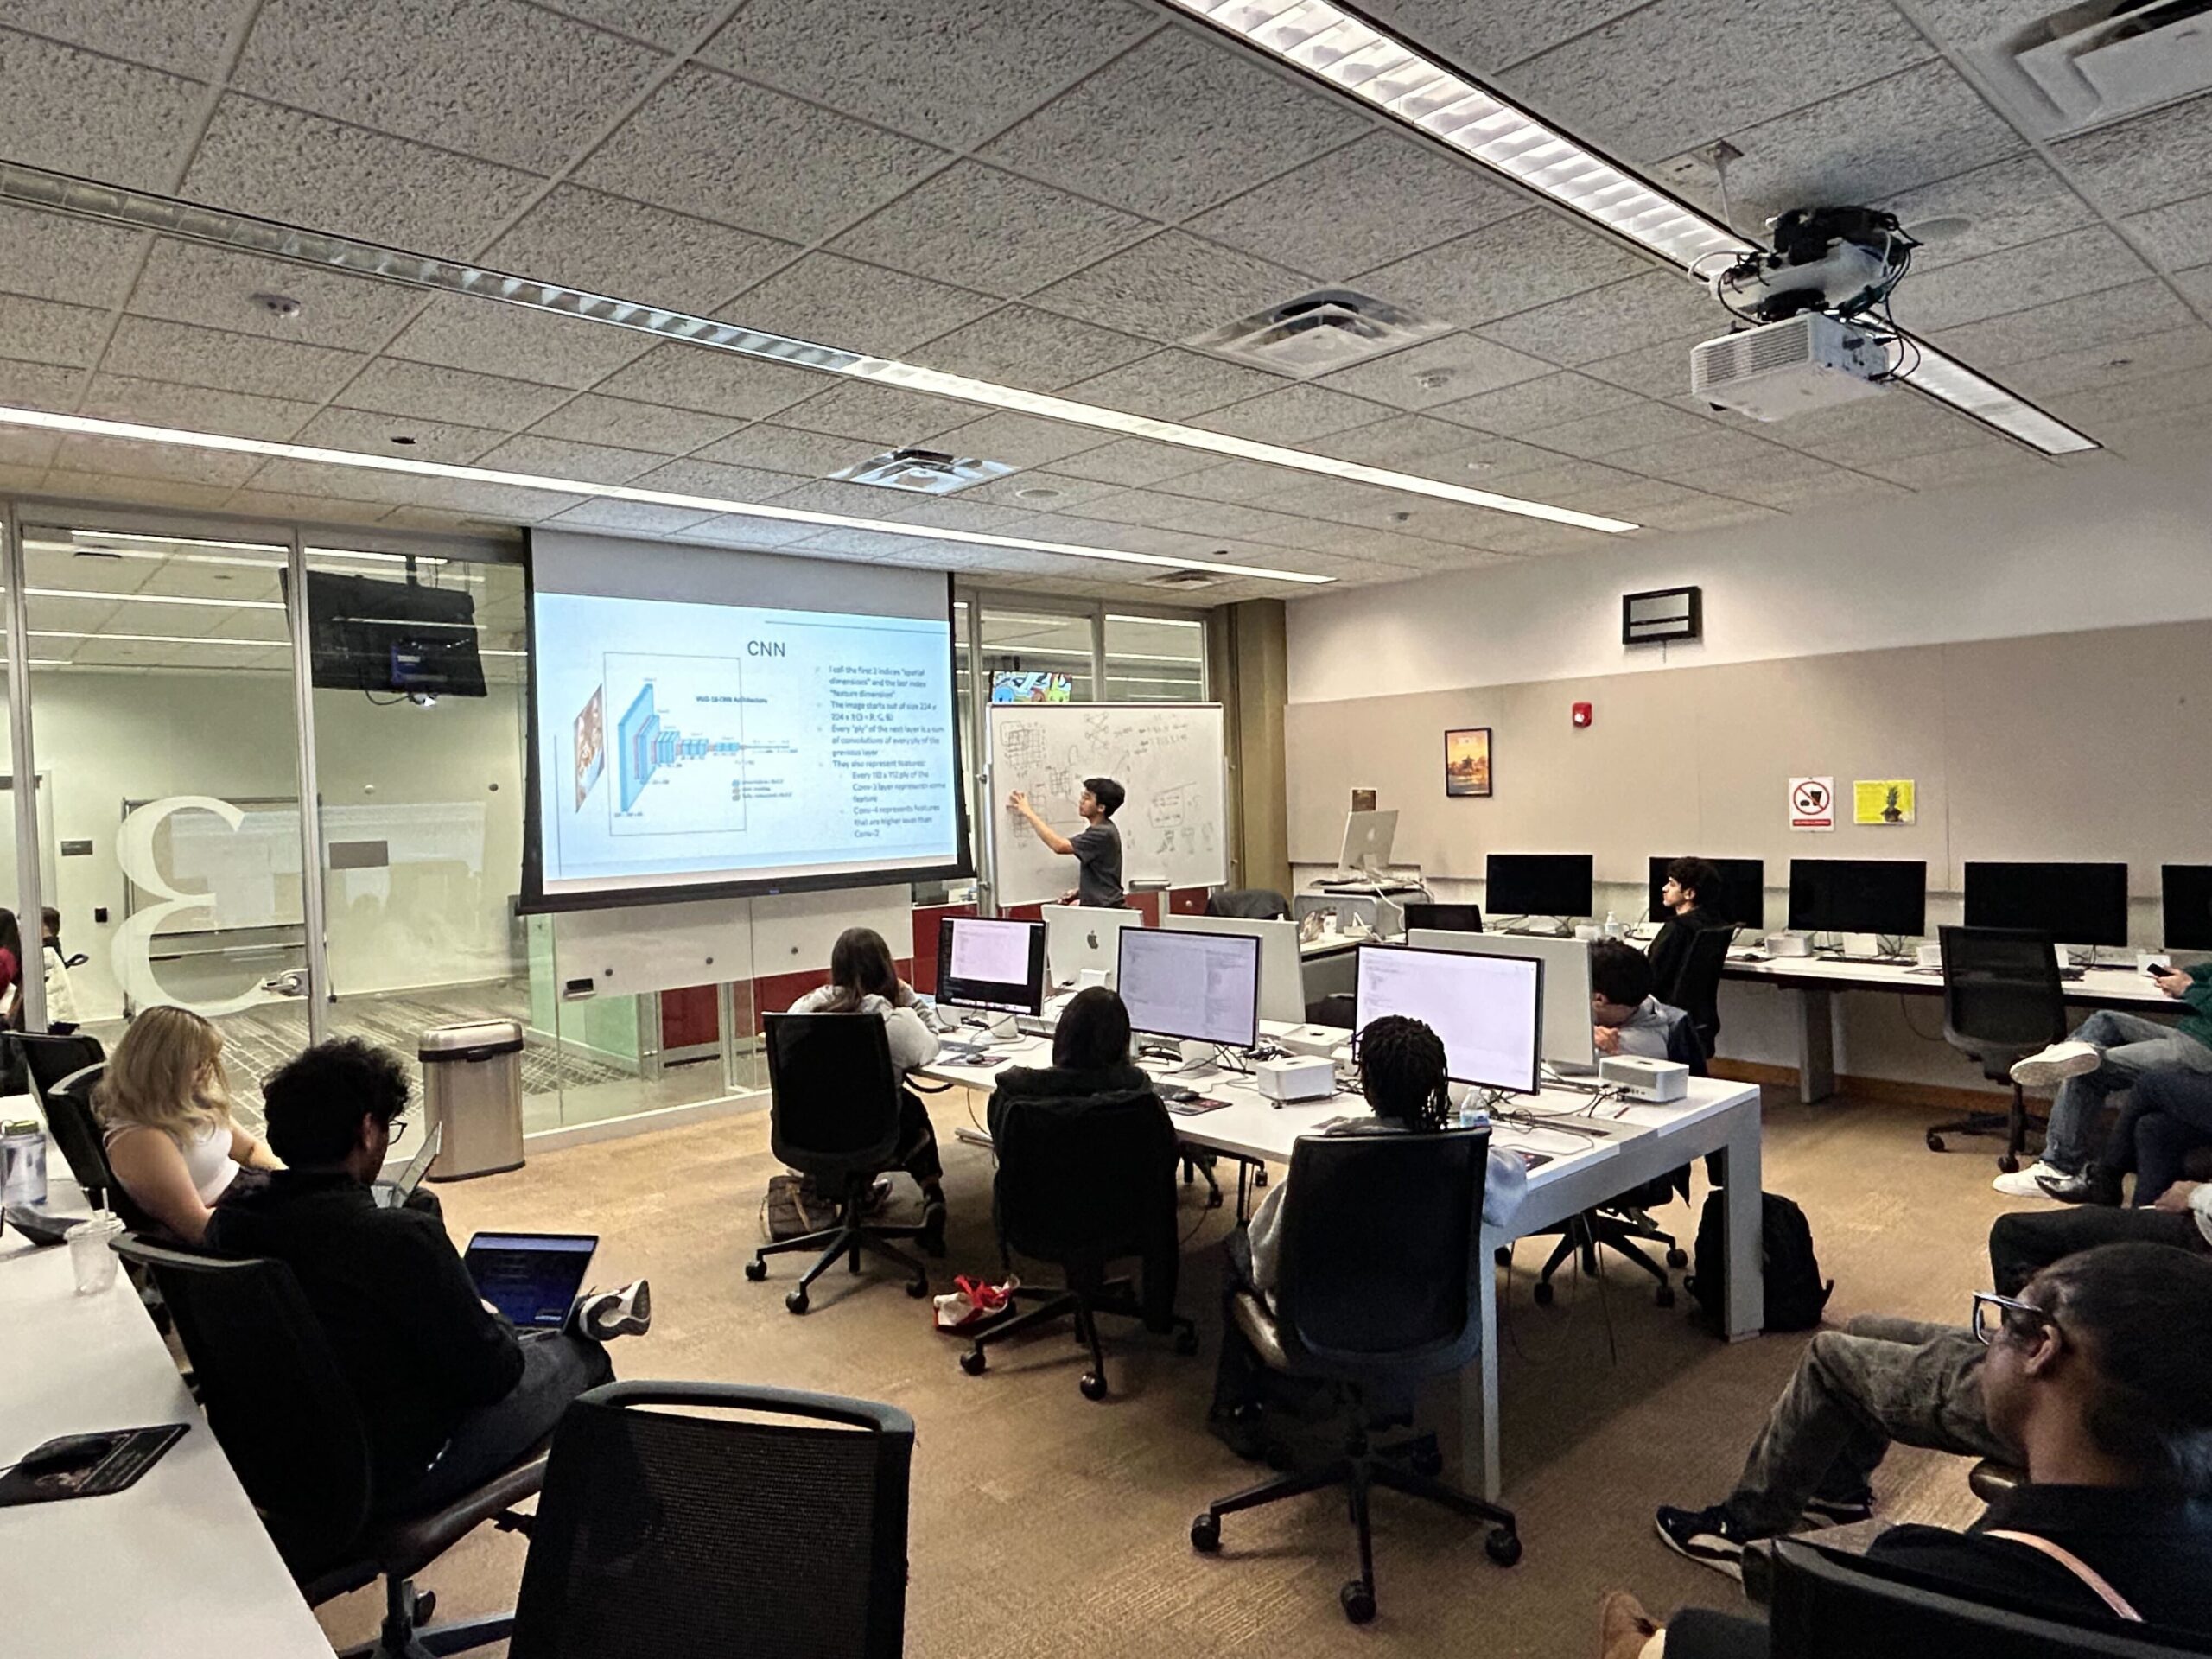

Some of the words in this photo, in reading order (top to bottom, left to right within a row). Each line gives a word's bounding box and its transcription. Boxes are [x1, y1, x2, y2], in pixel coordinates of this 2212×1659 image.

[747, 640, 785, 657] CNN
[858, 666, 871, 675] first
[845, 701, 864, 710] image
[831, 724, 850, 733] Every
[879, 805, 913, 814] represents
[881, 817, 900, 826] higher
